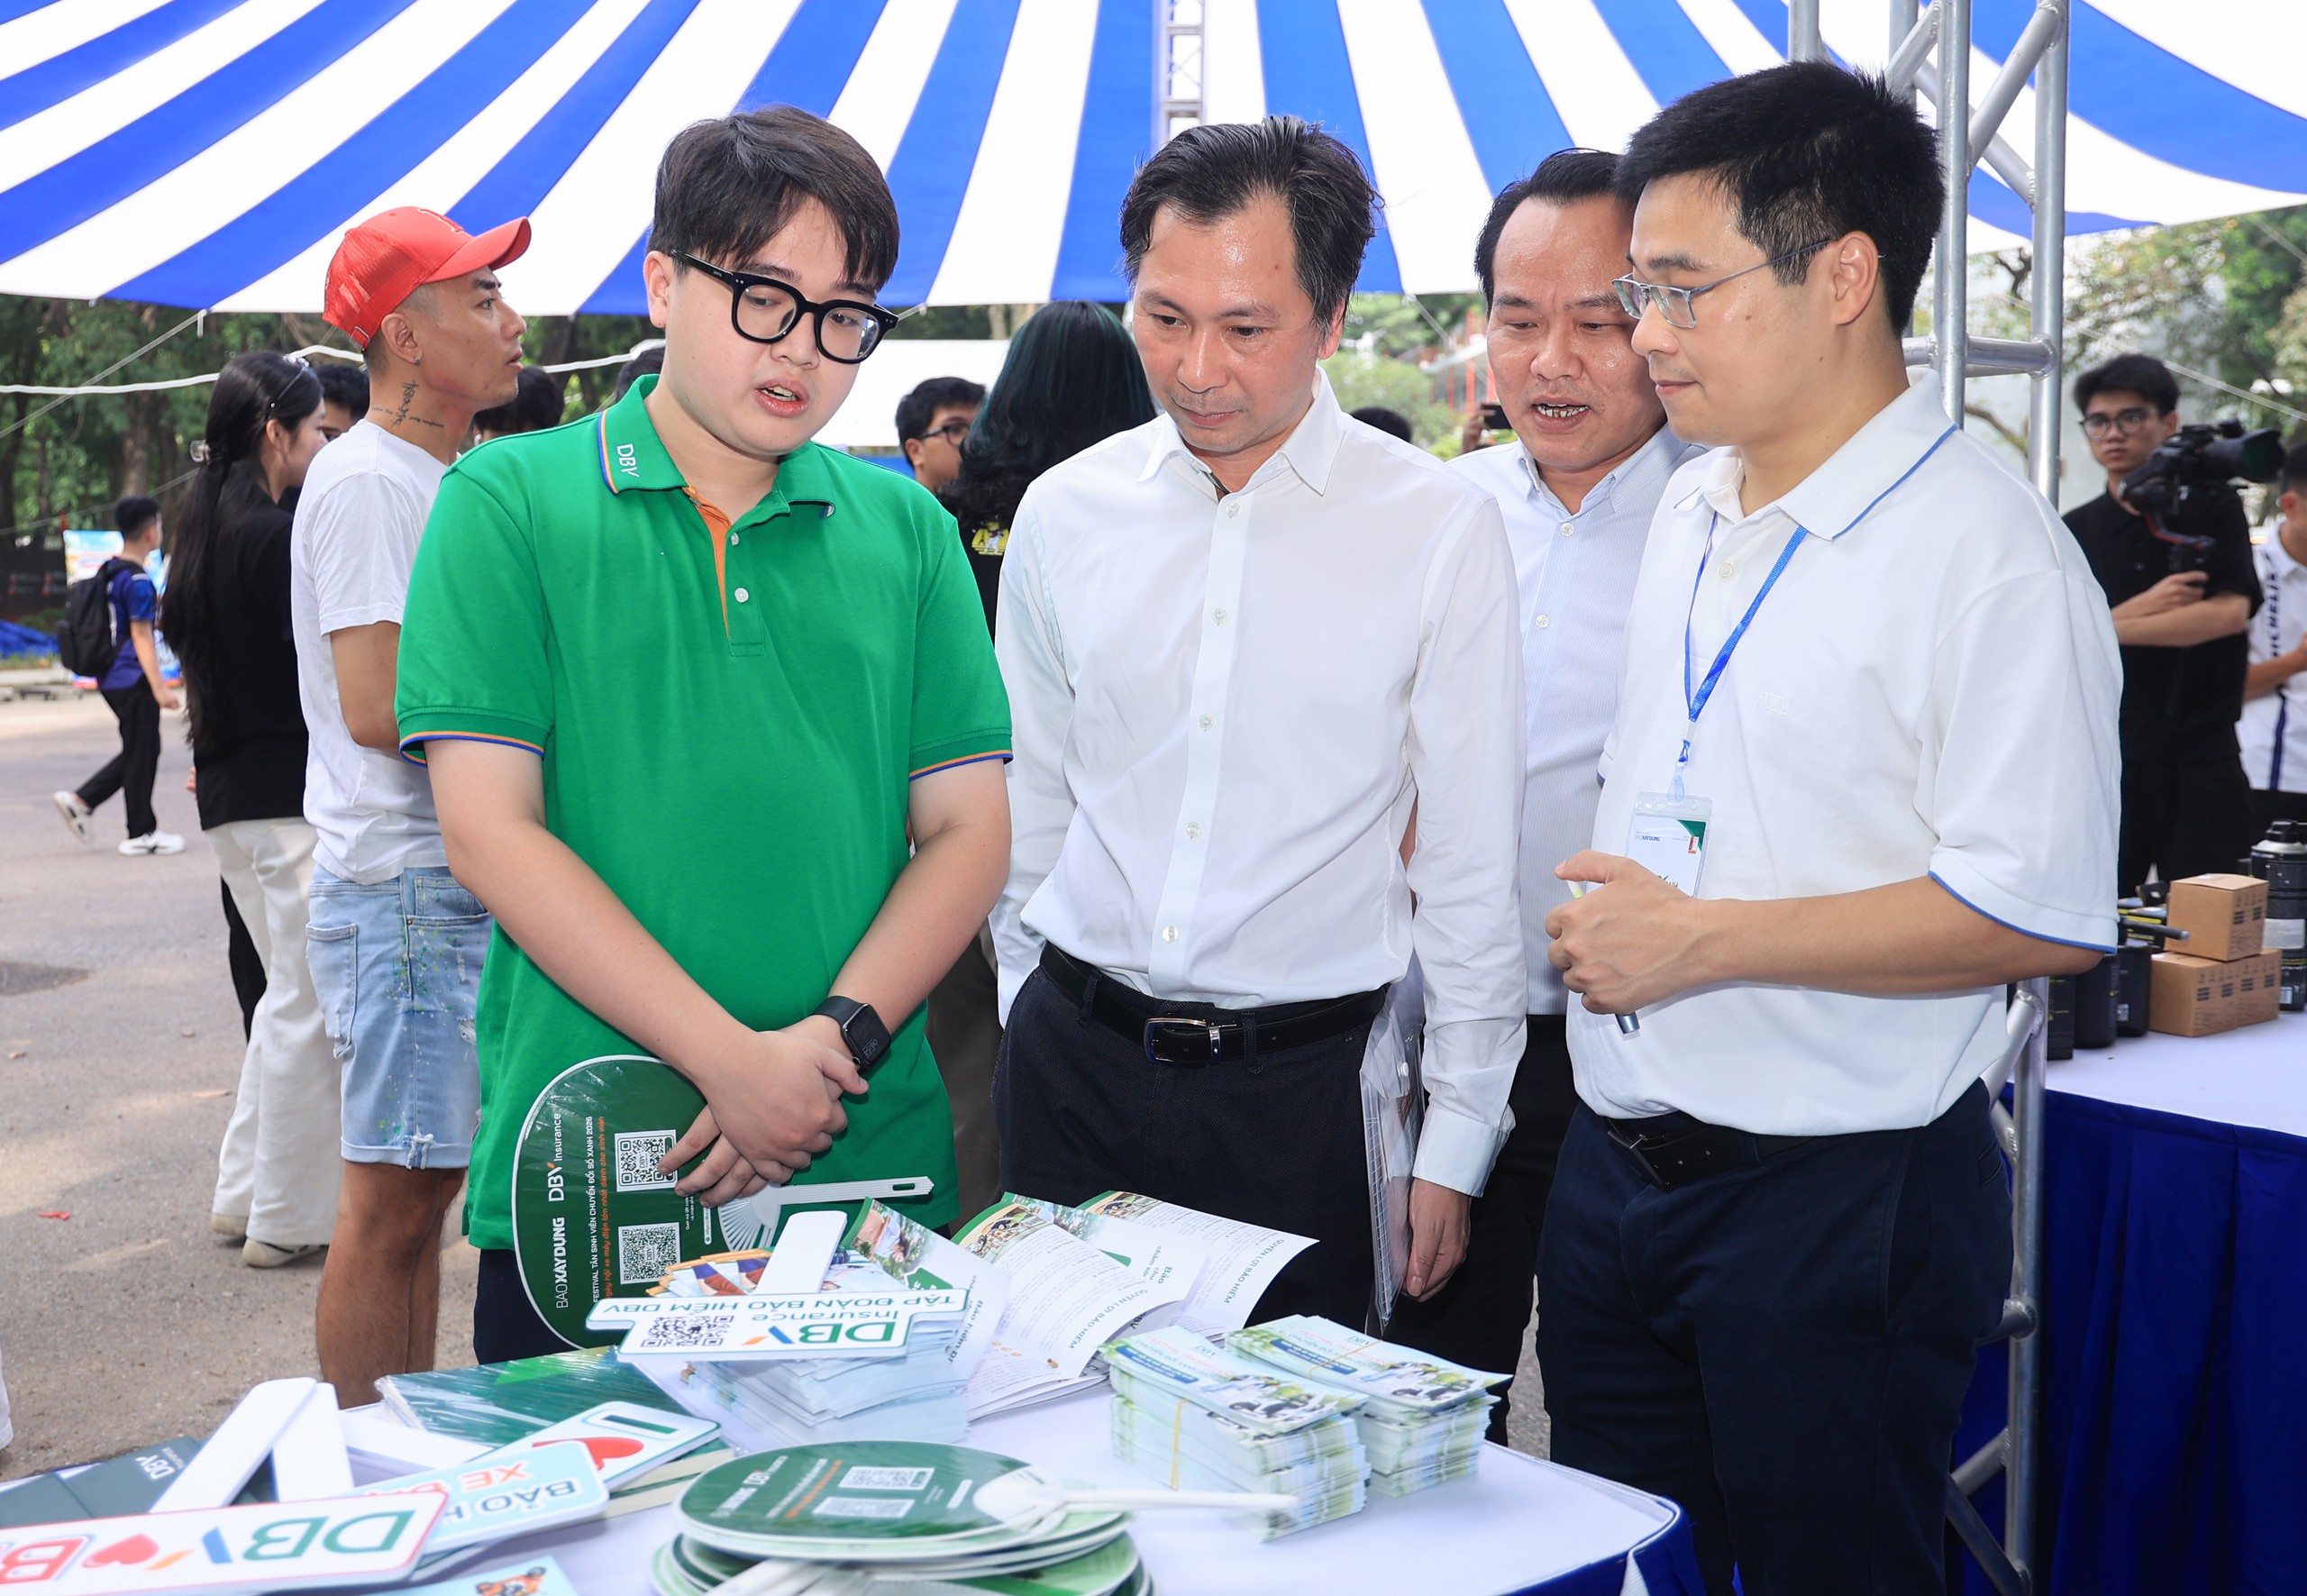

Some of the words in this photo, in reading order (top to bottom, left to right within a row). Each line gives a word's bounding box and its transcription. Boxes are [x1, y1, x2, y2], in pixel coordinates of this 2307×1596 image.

[616, 442, 640, 478] DBV
[552, 1113, 563, 1161] Insurance
[597, 1134, 606, 1150] sinh
[584, 1159, 594, 1169] SỐ
[547, 1163, 564, 1201] DBV
[584, 1171, 595, 1183] ĐỔI
[586, 1185, 596, 1216] CHUYỂN
[588, 1218, 597, 1234] VIÊN
[602, 1242, 611, 1256] máy
[590, 1254, 598, 1268] TÂN
[604, 1259, 610, 1267] xe
[604, 1282, 613, 1299] gày
[603, 1303, 662, 1314] DBV
[670, 1302, 738, 1316] HIỂM
[748, 1300, 805, 1314] BẢO
[809, 1298, 893, 1311] ĐOÀN
[903, 1294, 954, 1308] TẬP
[752, 1310, 898, 1324] Insurance
[741, 1322, 896, 1347] DBV
[134, 1454, 175, 1480] DBV
[465, 1463, 527, 1491] XE
[481, 1481, 575, 1514] BẢO
[144, 1509, 415, 1570] DBV
